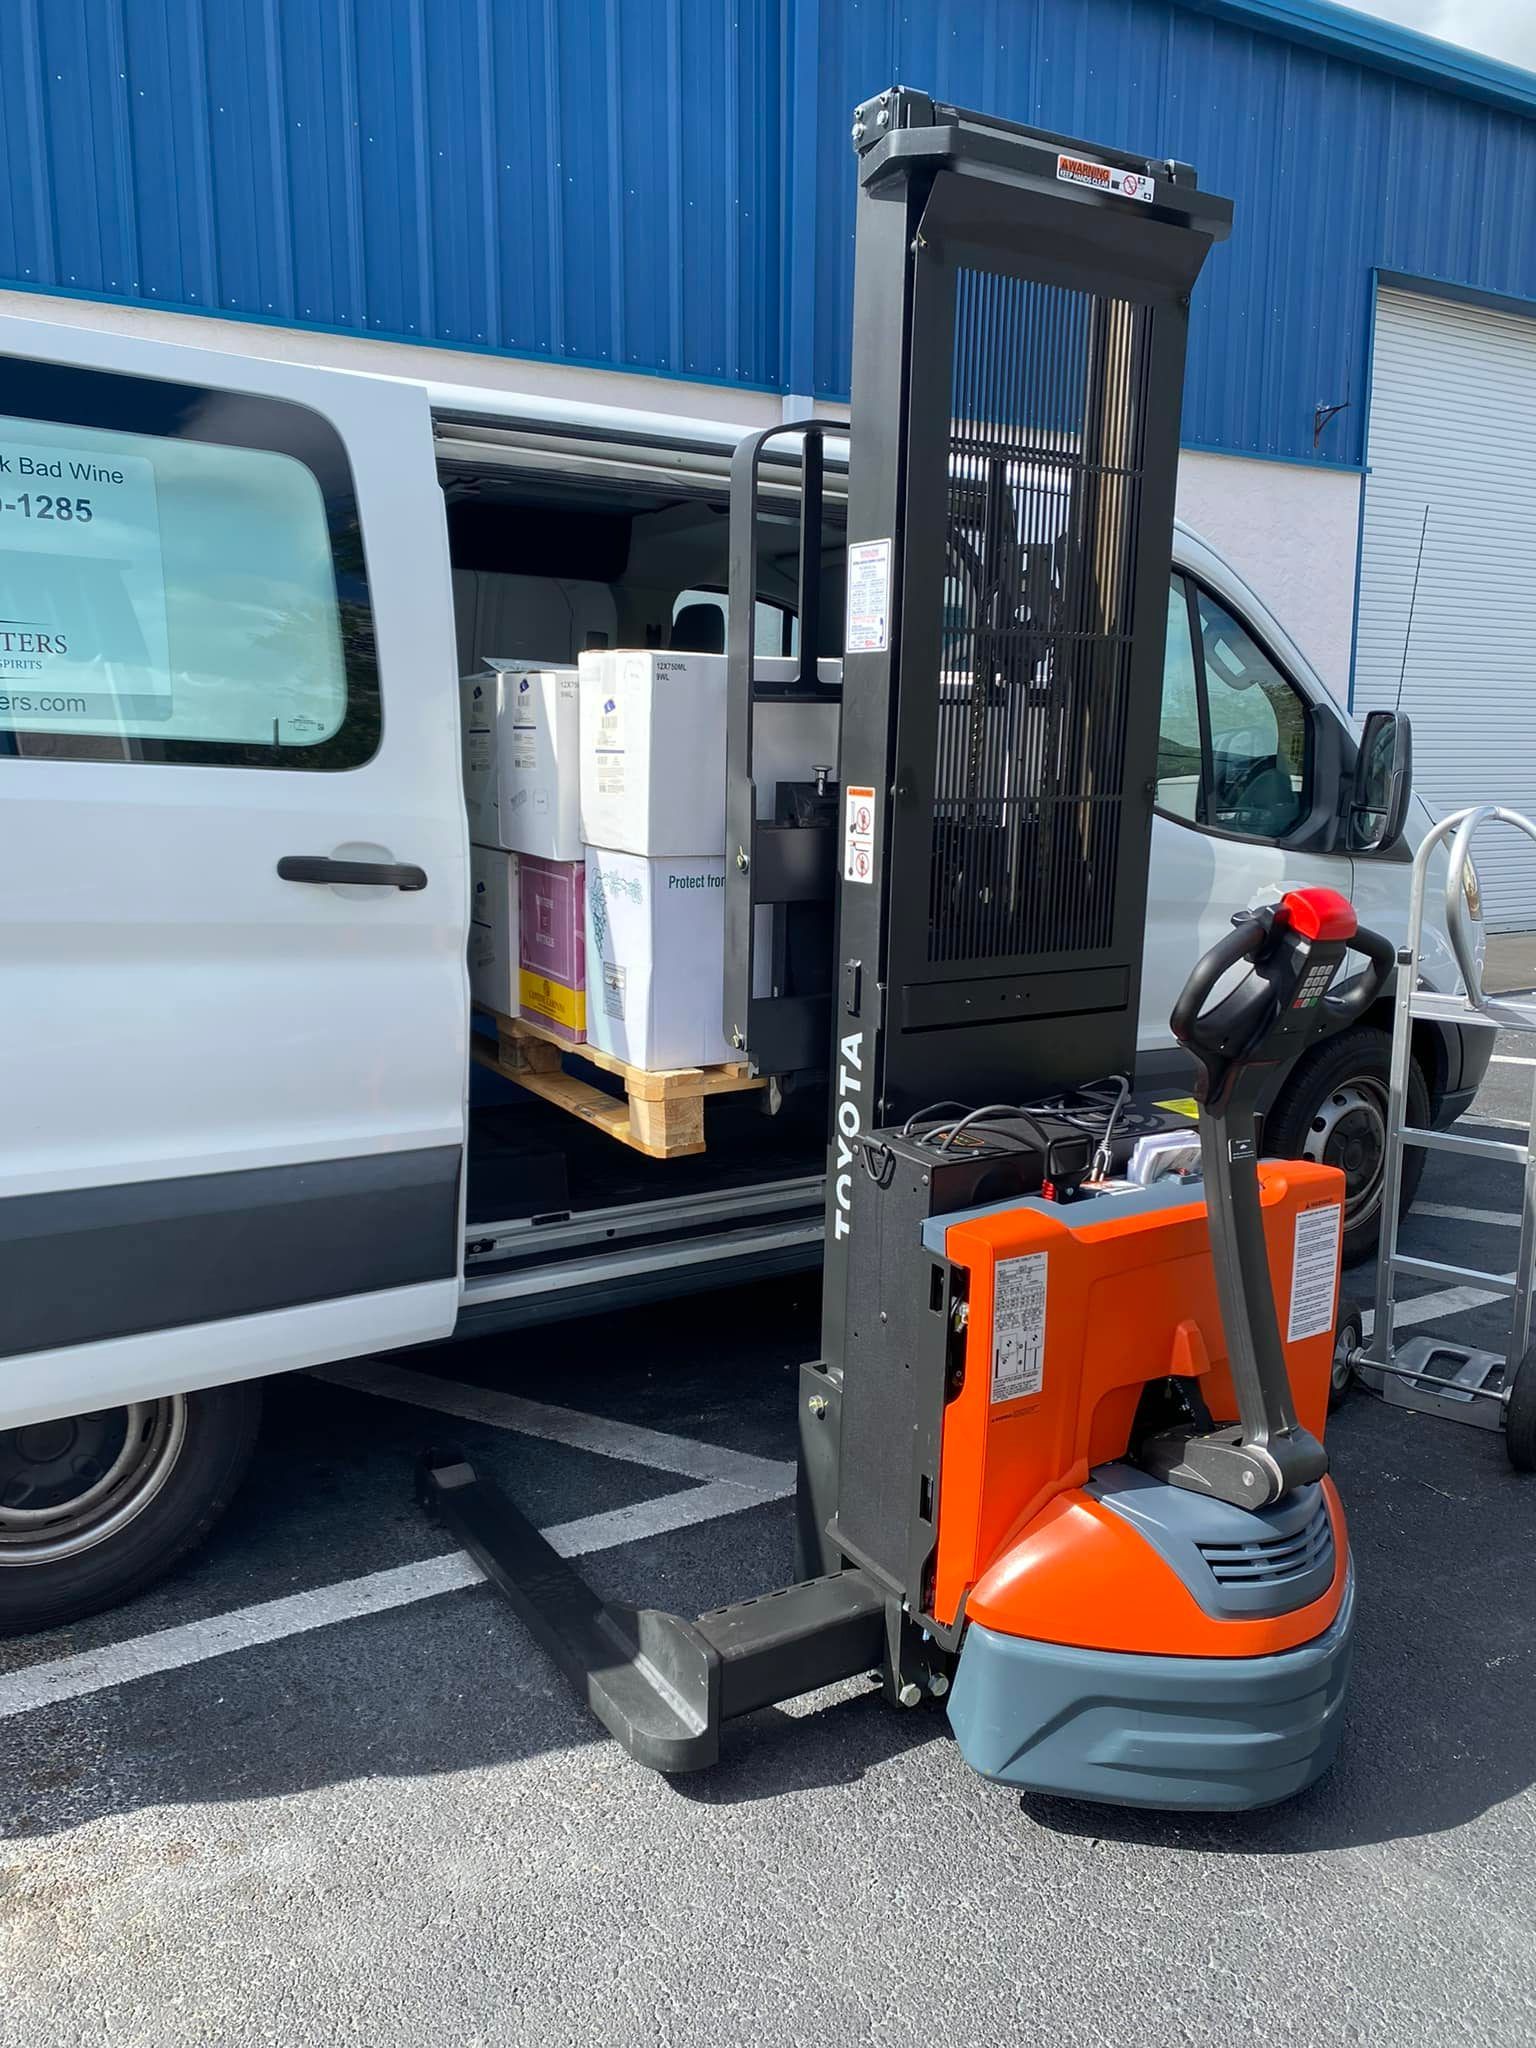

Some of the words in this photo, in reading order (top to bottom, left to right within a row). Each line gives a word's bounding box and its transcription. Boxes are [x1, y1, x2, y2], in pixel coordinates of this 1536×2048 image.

[1069, 160, 1109, 180] WARNING
[19, 456, 62, 478] Bad
[69, 462, 124, 484] Wine
[0, 493, 93, 523] -1285
[0, 696, 86, 712] ers.com
[668, 874, 704, 889] Protect
[834, 1032, 863, 1240] TOYOTA
